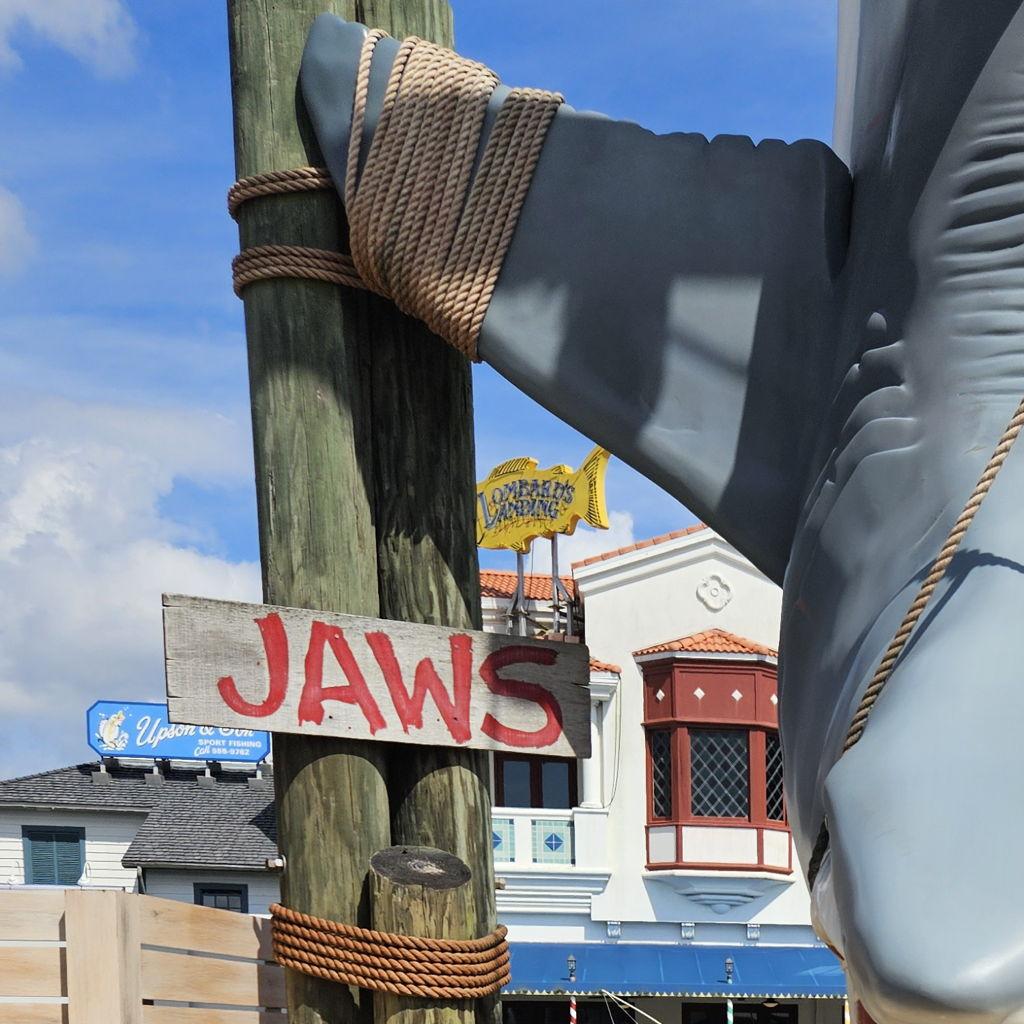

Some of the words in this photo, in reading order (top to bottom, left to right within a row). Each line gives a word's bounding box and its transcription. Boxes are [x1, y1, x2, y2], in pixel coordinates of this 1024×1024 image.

[217, 612, 563, 748] JAWS
[136, 716, 196, 748] Upson
[198, 739, 226, 747] SPORT
[228, 740, 262, 749] FISHING
